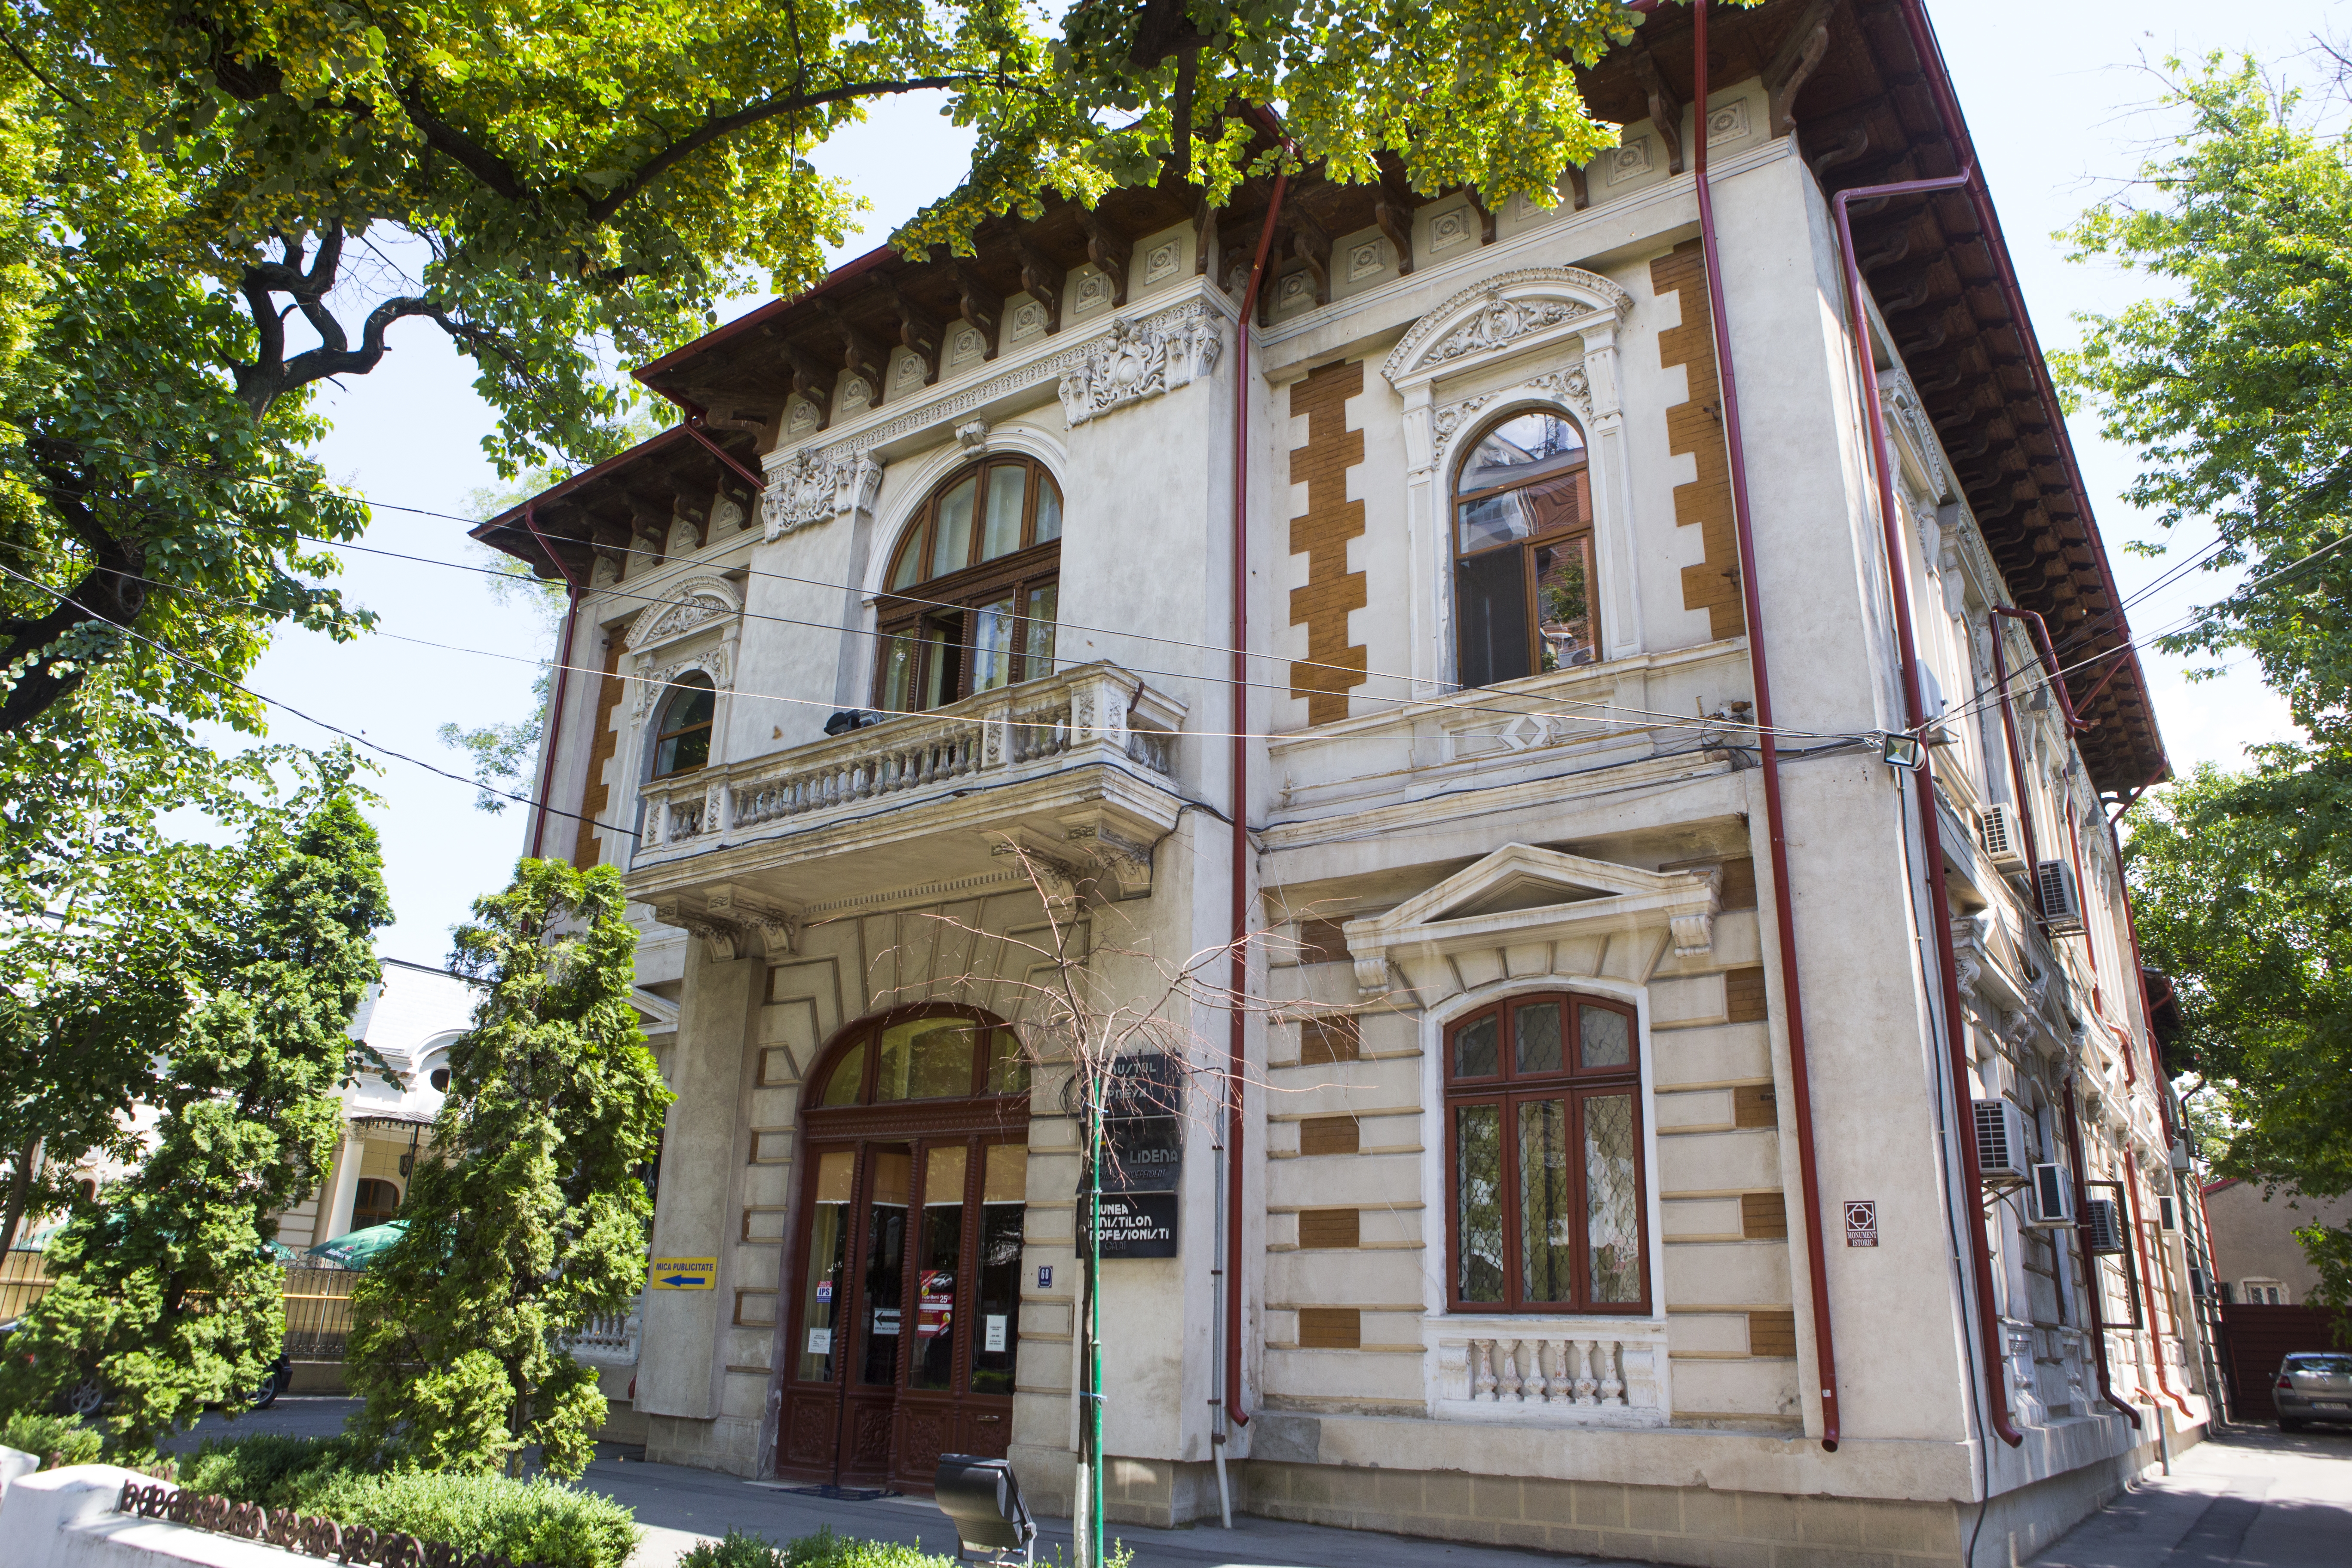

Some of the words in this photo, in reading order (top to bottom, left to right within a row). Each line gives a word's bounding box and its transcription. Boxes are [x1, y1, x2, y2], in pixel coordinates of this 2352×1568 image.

[1127, 1169, 1166, 1179] INDEPENDENT
[673, 1263, 714, 1271] PUBLICITATE
[1041, 1268, 1049, 1280] 68
[940, 1295, 947, 1303] 25
